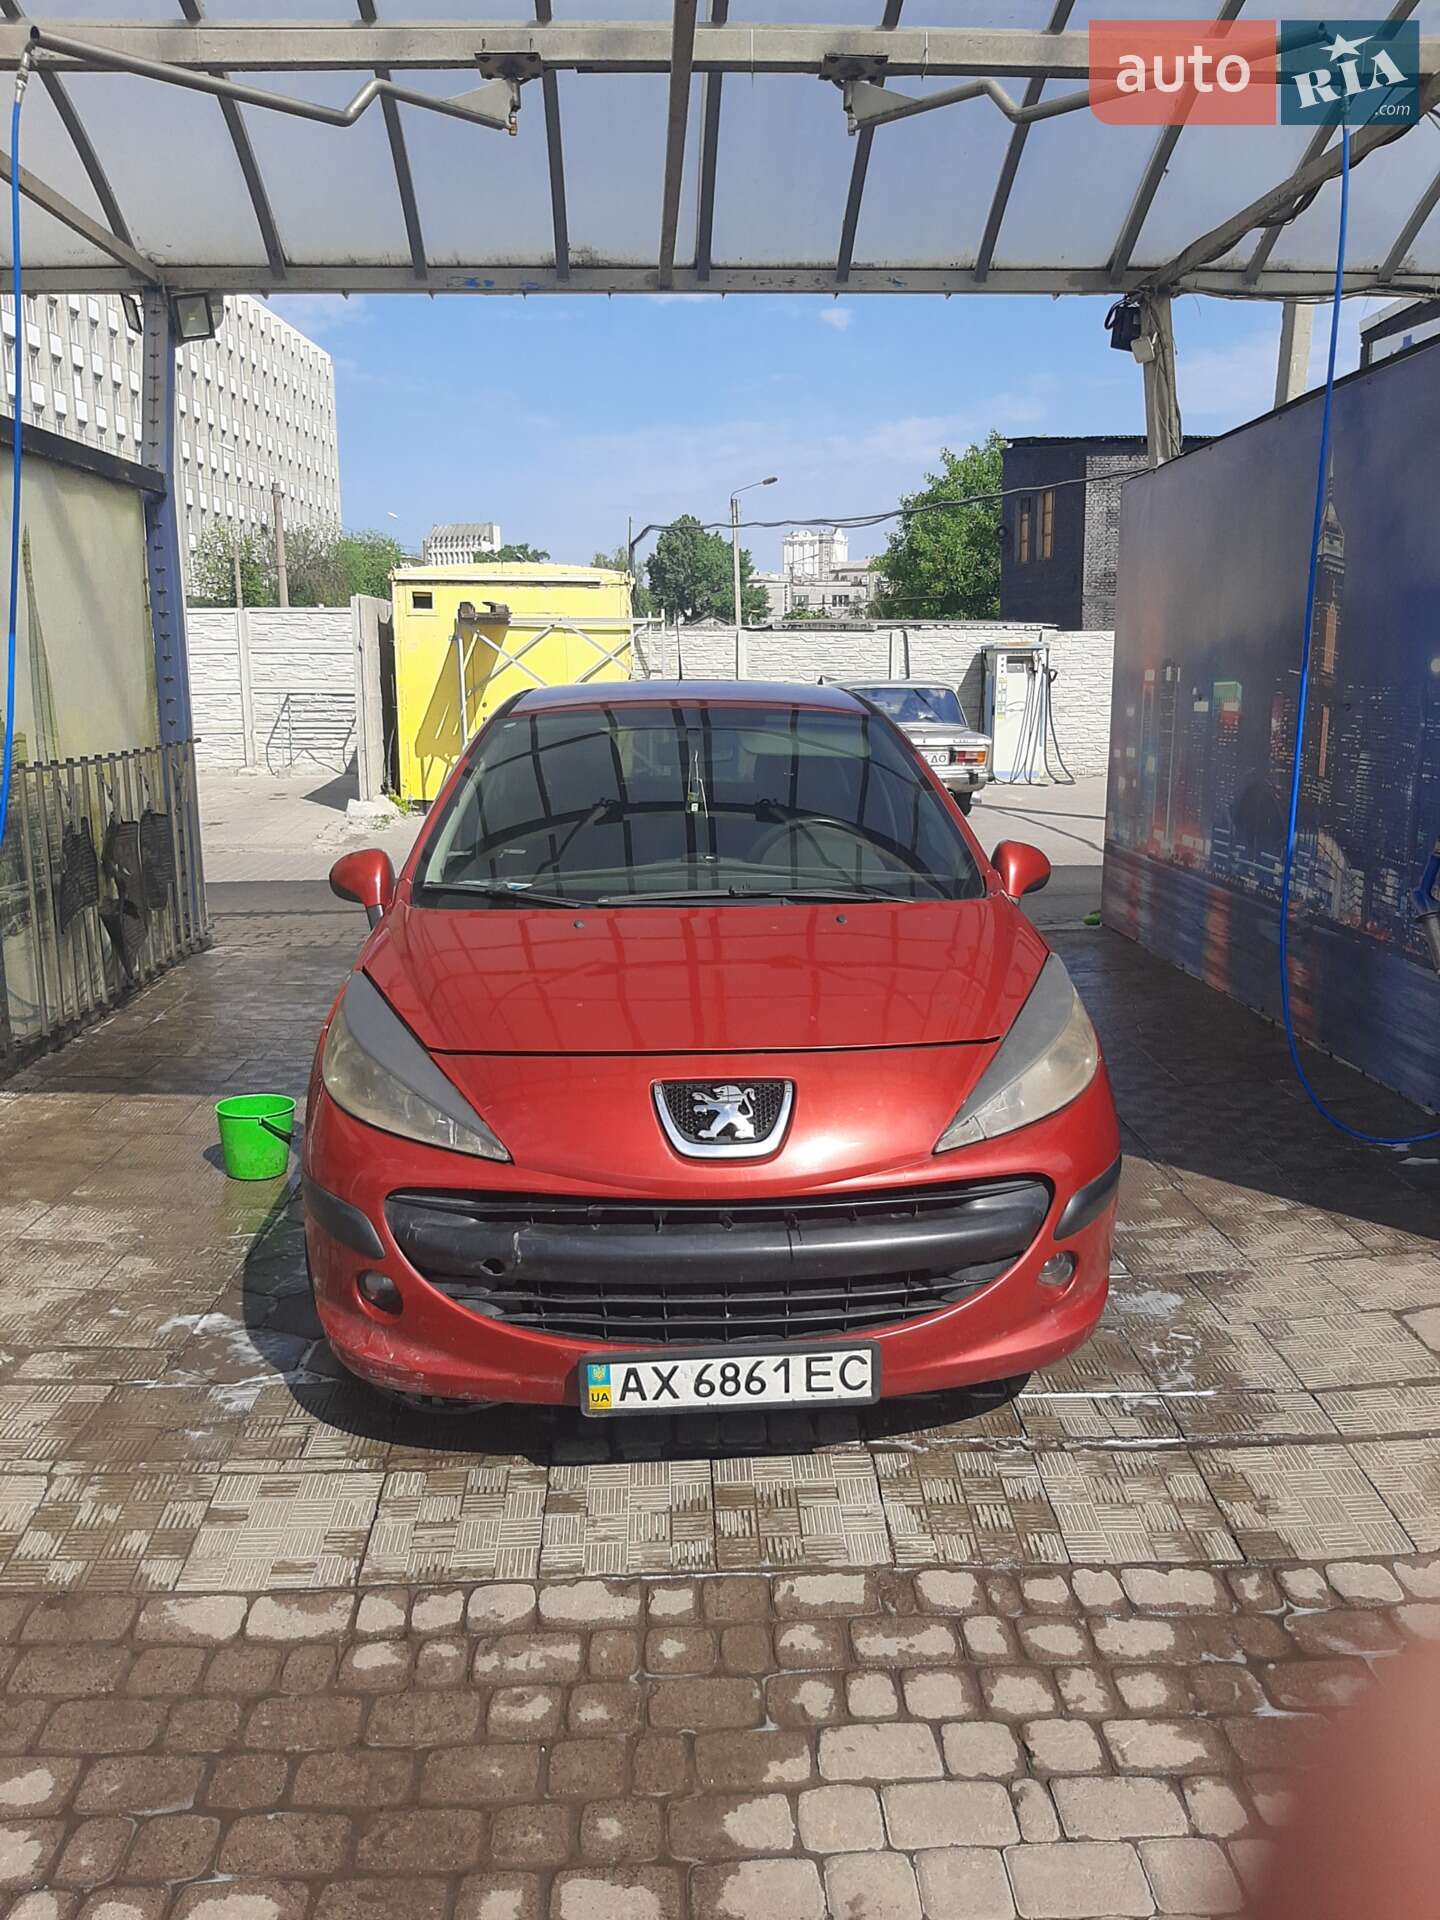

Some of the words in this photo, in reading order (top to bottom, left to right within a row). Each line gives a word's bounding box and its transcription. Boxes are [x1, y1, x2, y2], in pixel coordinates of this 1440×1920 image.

[619, 1365, 680, 1401] AX
[693, 1358, 790, 1398] 6861
[805, 1354, 868, 1393] EC
[591, 1393, 609, 1402] UA
